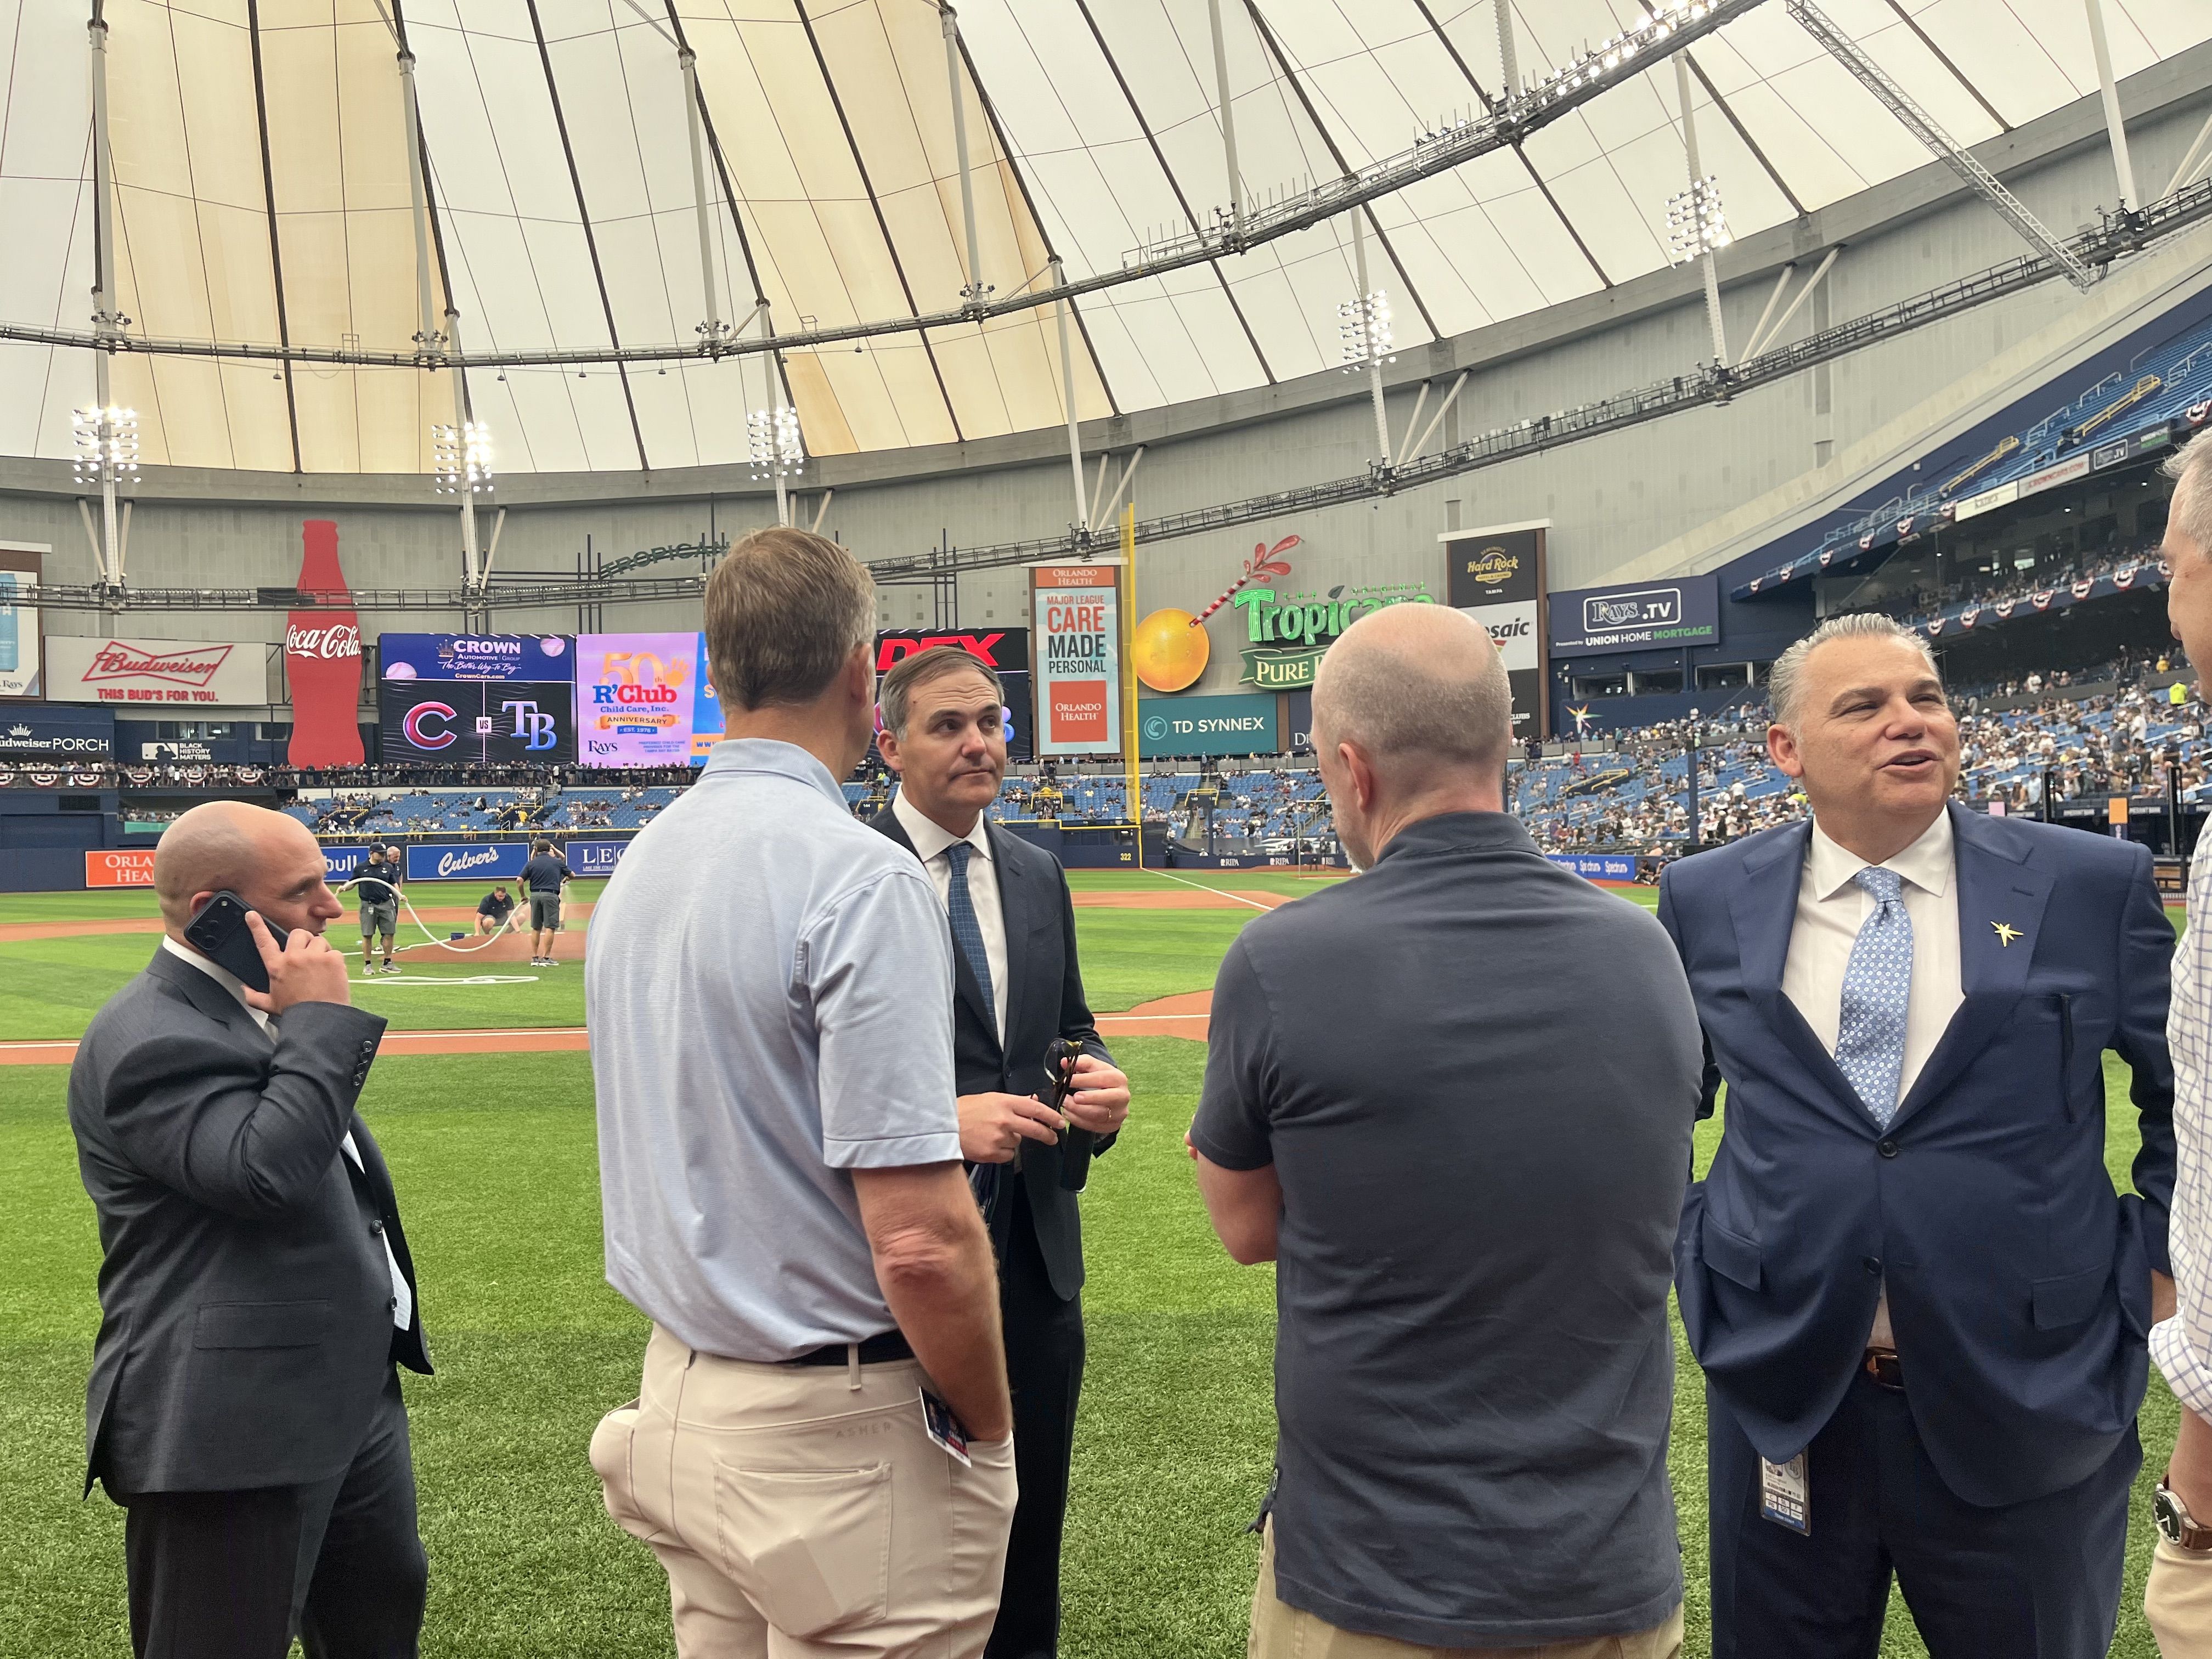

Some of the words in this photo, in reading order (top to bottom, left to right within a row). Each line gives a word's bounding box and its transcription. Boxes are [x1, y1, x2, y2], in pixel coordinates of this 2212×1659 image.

[1467, 558, 1493, 573] Hard
[1494, 555, 1519, 571] Rock
[1053, 569, 1097, 577] ORLANDO
[1351, 580, 1426, 596] ORIGINAL
[1047, 596, 1074, 605] MAJOR
[1076, 595, 1104, 604] LEAGUE
[1048, 606, 1105, 633] CARE
[1234, 589, 1435, 645] Tropic
[1592, 601, 1638, 624] RAYS
[286, 624, 361, 659] Coca-Cola
[1585, 634, 1619, 647] UNION
[1621, 631, 1652, 643] HOME
[1654, 625, 1712, 640] MORTGAGE
[453, 640, 521, 653] CROWN
[1048, 634, 1106, 658] MADE
[96, 652, 219, 674] Budweiser
[437, 658, 454, 669] The
[477, 662, 492, 674] Way
[492, 662, 501, 670] To
[1049, 659, 1106, 673] PERSONAL
[1256, 661, 1310, 682] PURE
[3, 680, 22, 689] RAYS
[97, 689, 124, 699] THIS
[128, 689, 163, 701] BUD'S
[166, 690, 189, 701] FOR
[191, 690, 218, 702] YOU.
[592, 684, 678, 704] R'Club
[626, 706, 650, 714] Care,
[1056, 703, 1102, 712] ORLANDO
[607, 716, 668, 725] ANNIVERSARY
[1060, 712, 1097, 721] HEALTH
[403, 701, 458, 751] C
[479, 720, 488, 729] VS
[1172, 720, 1193, 733] TD
[1198, 716, 1265, 732] SYNNEX
[53, 737, 109, 752] PORCH
[588, 740, 618, 754] RAYS
[438, 846, 499, 876] Culver's
[1120, 853, 1132, 861] 322
[1580, 859, 1599, 873] Spectrum
[1605, 860, 1627, 875] Spectrum
